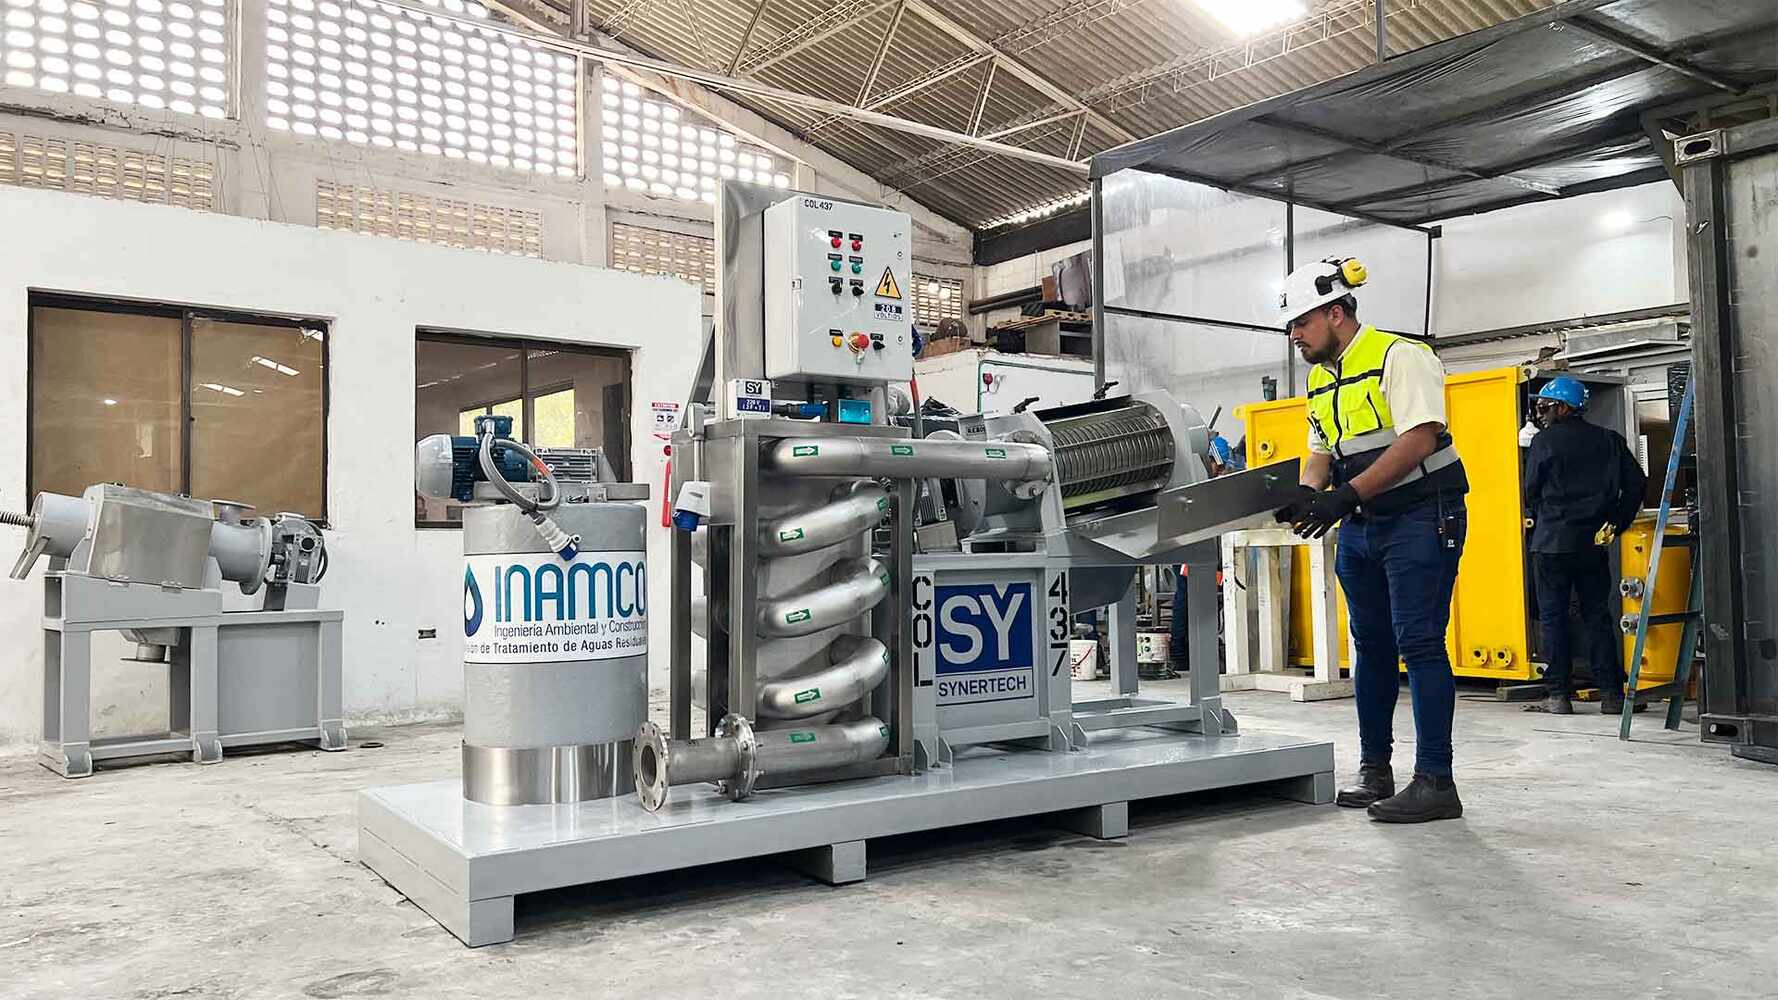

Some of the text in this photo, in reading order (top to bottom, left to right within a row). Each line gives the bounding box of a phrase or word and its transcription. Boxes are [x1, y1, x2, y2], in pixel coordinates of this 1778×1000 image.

[746, 382, 761, 393] SY
[495, 561, 646, 622] INAMCO
[495, 624, 543, 641] Ingeniería
[545, 621, 599, 637] Ambiental
[601, 623, 607, 636] y
[940, 593, 1025, 665] SY
[1049, 571, 1068, 677] 437
[480, 643, 490, 654] de
[493, 641, 559, 654] Tratamiento
[563, 640, 577, 652] de
[581, 639, 613, 653] Aguas
[938, 675, 1027, 697] SYNERTECH
